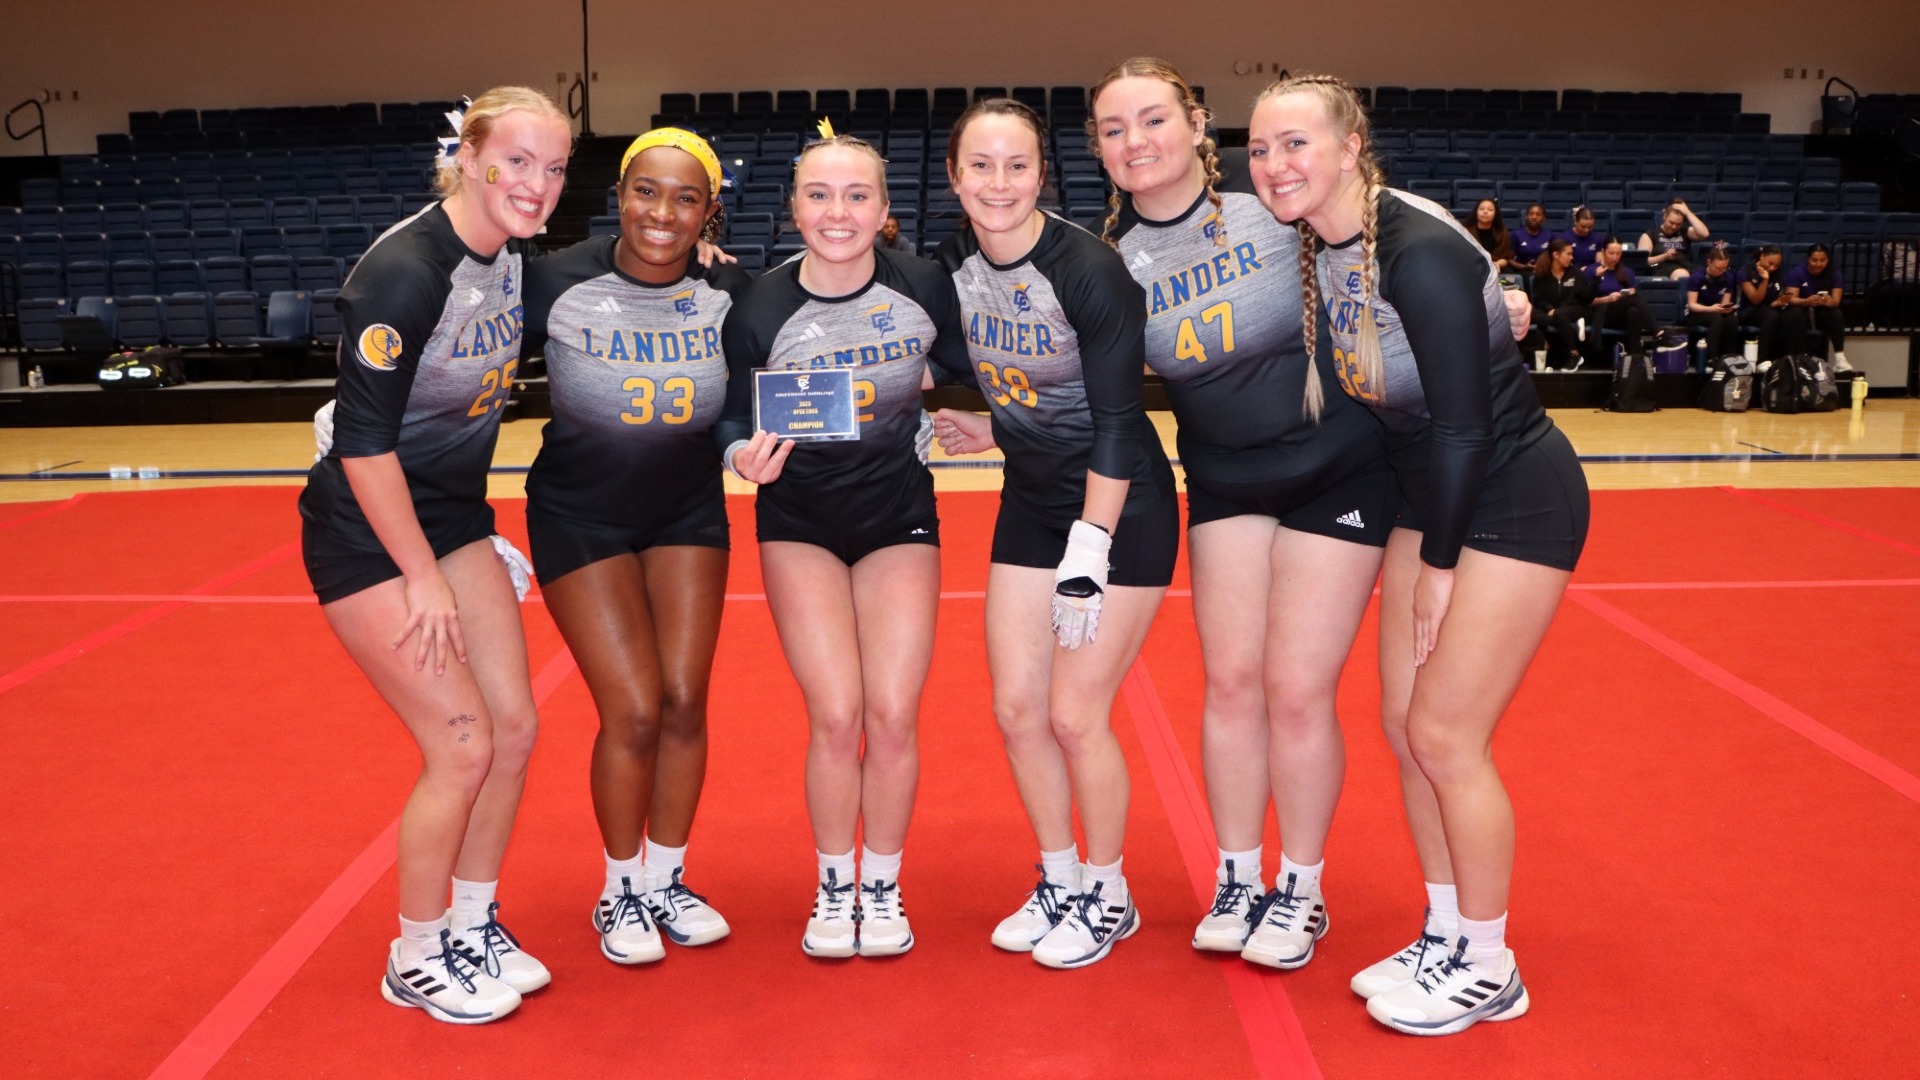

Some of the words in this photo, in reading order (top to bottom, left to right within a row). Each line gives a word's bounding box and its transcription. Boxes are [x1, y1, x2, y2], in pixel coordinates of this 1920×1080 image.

[1150, 240, 1264, 316] ANDER
[451, 303, 524, 360] LANDE
[581, 325, 721, 365] LANDER
[967, 311, 1058, 357] ANDER
[1174, 300, 1235, 363] 47
[467, 357, 518, 417] 25
[620, 376, 696, 425] 33
[978, 361, 1038, 409] 38
[788, 421, 824, 430] CHAMPION
